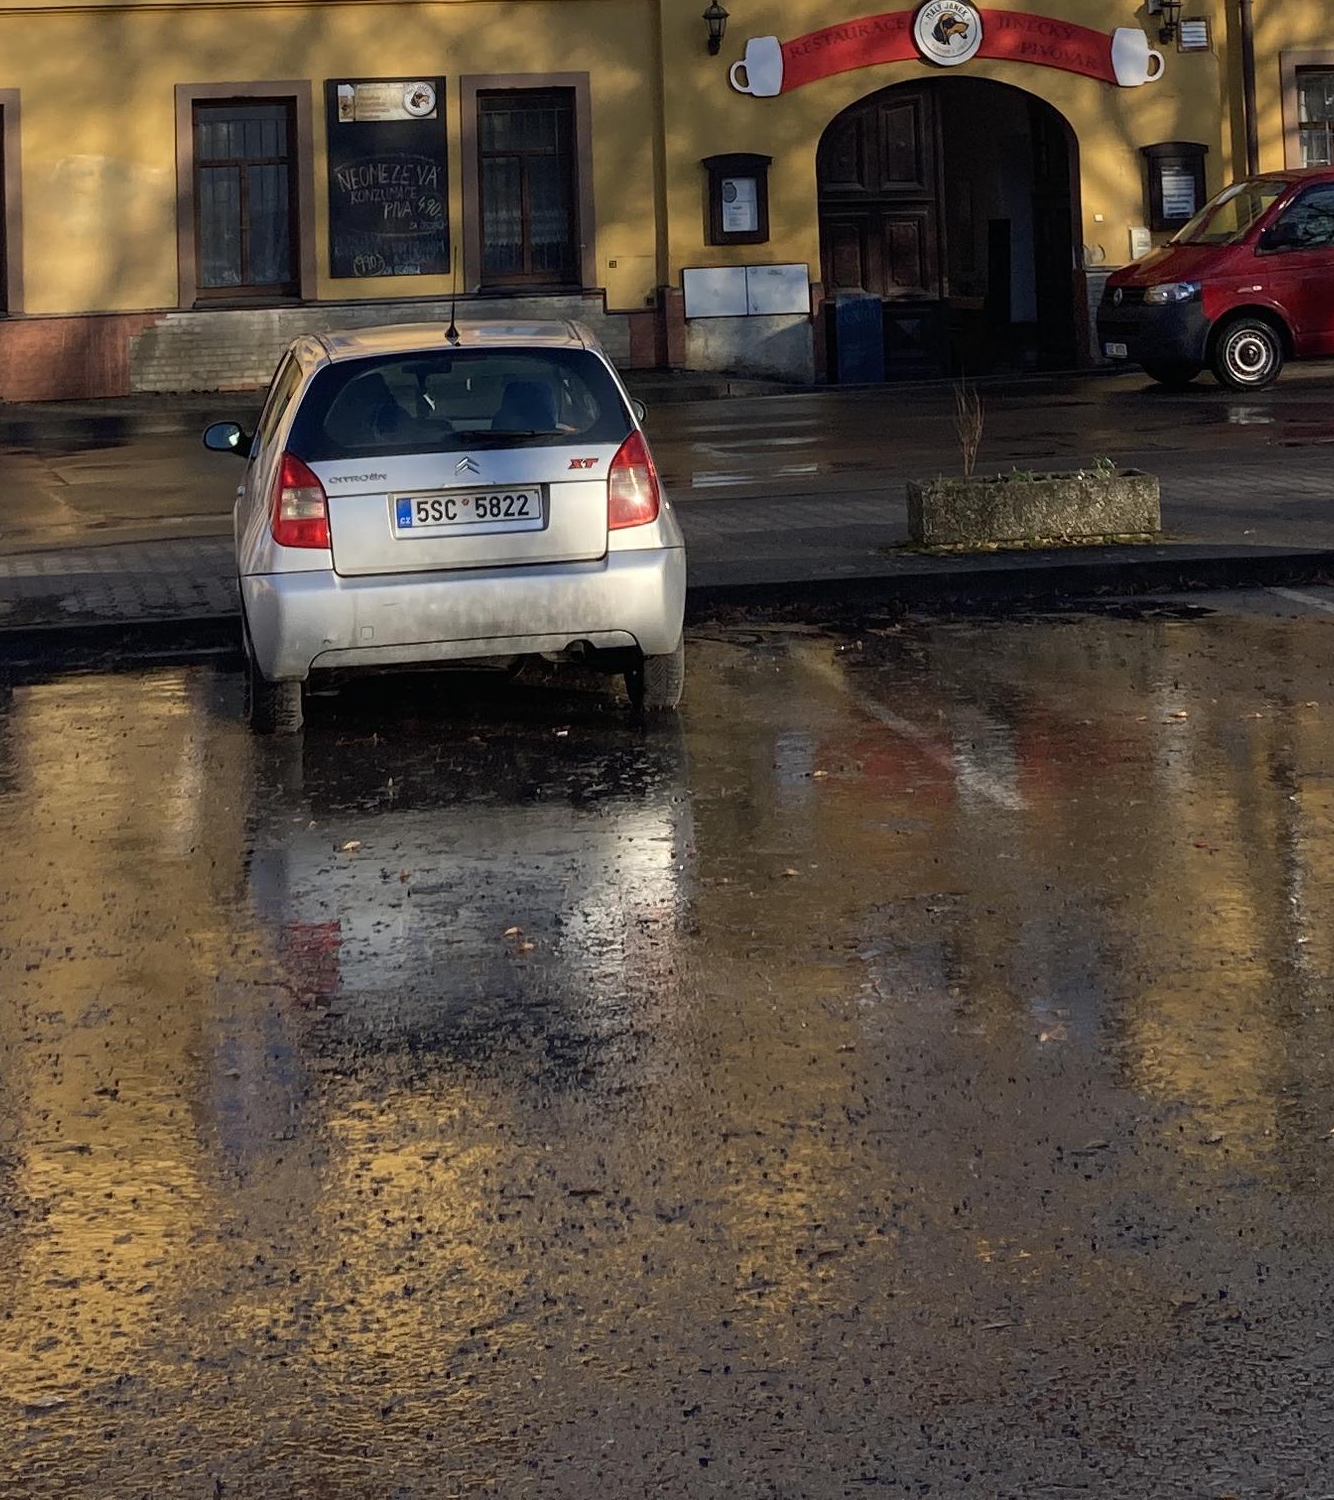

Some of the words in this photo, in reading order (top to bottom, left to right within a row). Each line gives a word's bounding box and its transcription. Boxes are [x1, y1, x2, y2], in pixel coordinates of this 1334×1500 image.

[944, 1, 969, 18] JANEK
[788, 17, 906, 58] RESTAURACE
[1019, 41, 1099, 69] PIVOVAR
[382, 201, 412, 220] PIVA
[416, 499, 457, 523] 5SC
[474, 494, 530, 518] 5822
[400, 517, 411, 525] CZ
